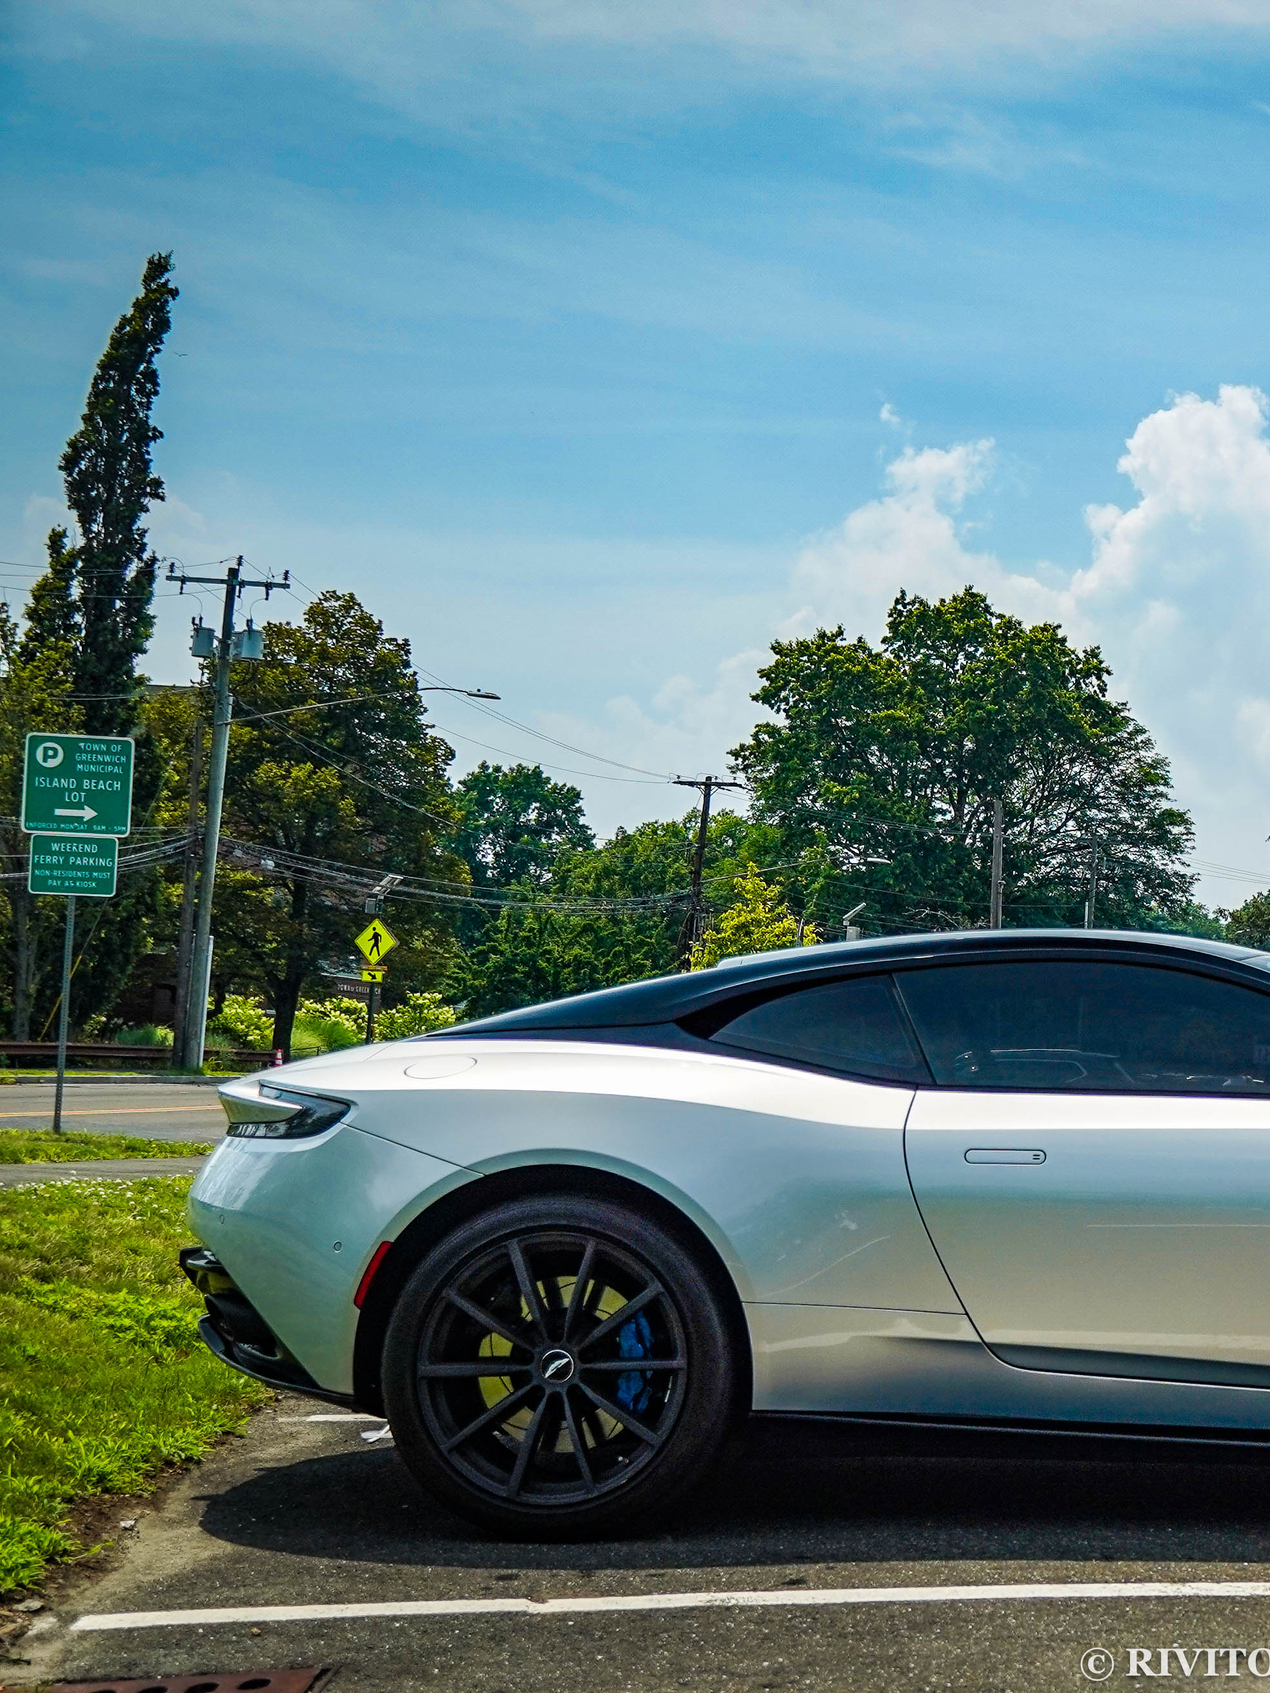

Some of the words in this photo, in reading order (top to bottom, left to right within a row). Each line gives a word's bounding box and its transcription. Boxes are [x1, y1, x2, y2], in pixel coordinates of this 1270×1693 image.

[78, 743, 107, 752] TOWN
[111, 744, 123, 752] OF
[76, 753, 127, 763] GREENWICH
[76, 764, 124, 774] MUNICIPAL
[35, 776, 77, 789] ISLAND
[83, 780, 121, 791] BEACH
[65, 792, 86, 803] LOT
[51, 842, 98, 853] WEEKEND
[34, 855, 65, 864] FERRY
[70, 856, 113, 867] PARKING
[34, 869, 90, 878] NON-RESIDENTS
